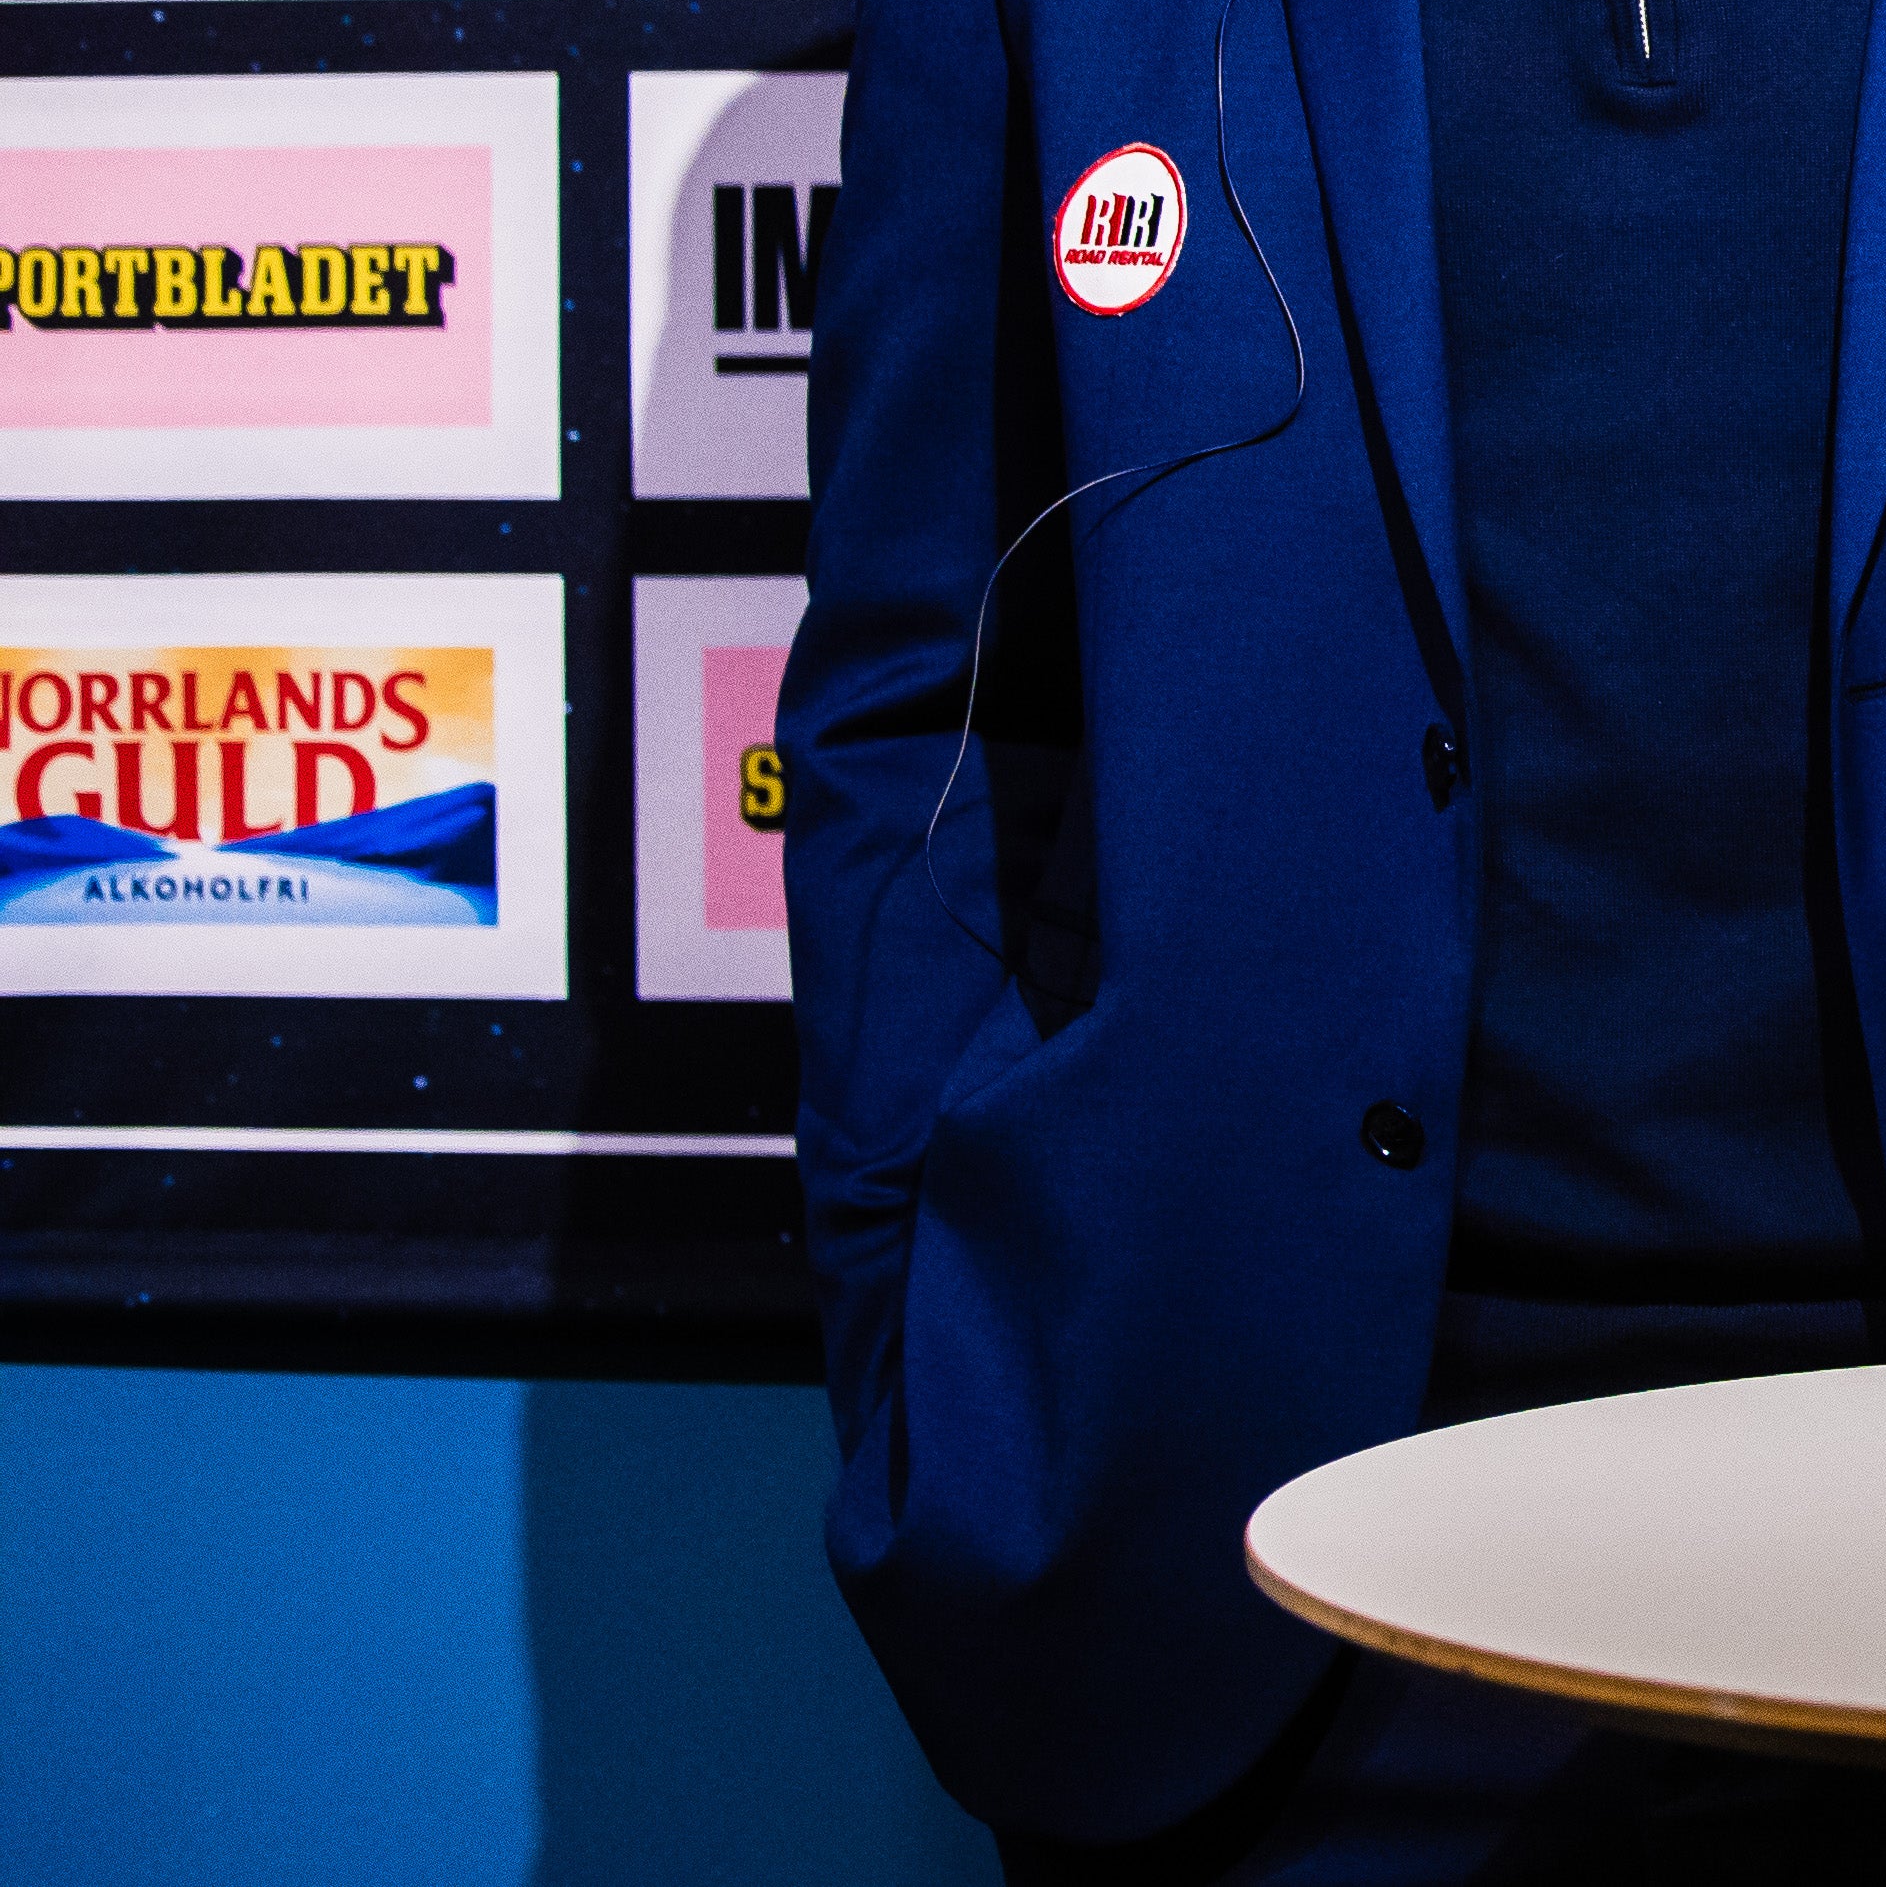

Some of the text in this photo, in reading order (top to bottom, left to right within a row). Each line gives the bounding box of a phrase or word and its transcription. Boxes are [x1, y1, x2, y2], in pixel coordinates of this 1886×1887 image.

[0, 244, 439, 317] ORTBLADET
[1064, 249, 1164, 267] ROAD RENTAL
[15, 740, 376, 841] GULD
[82, 874, 312, 904] ALKOHOLFRI
